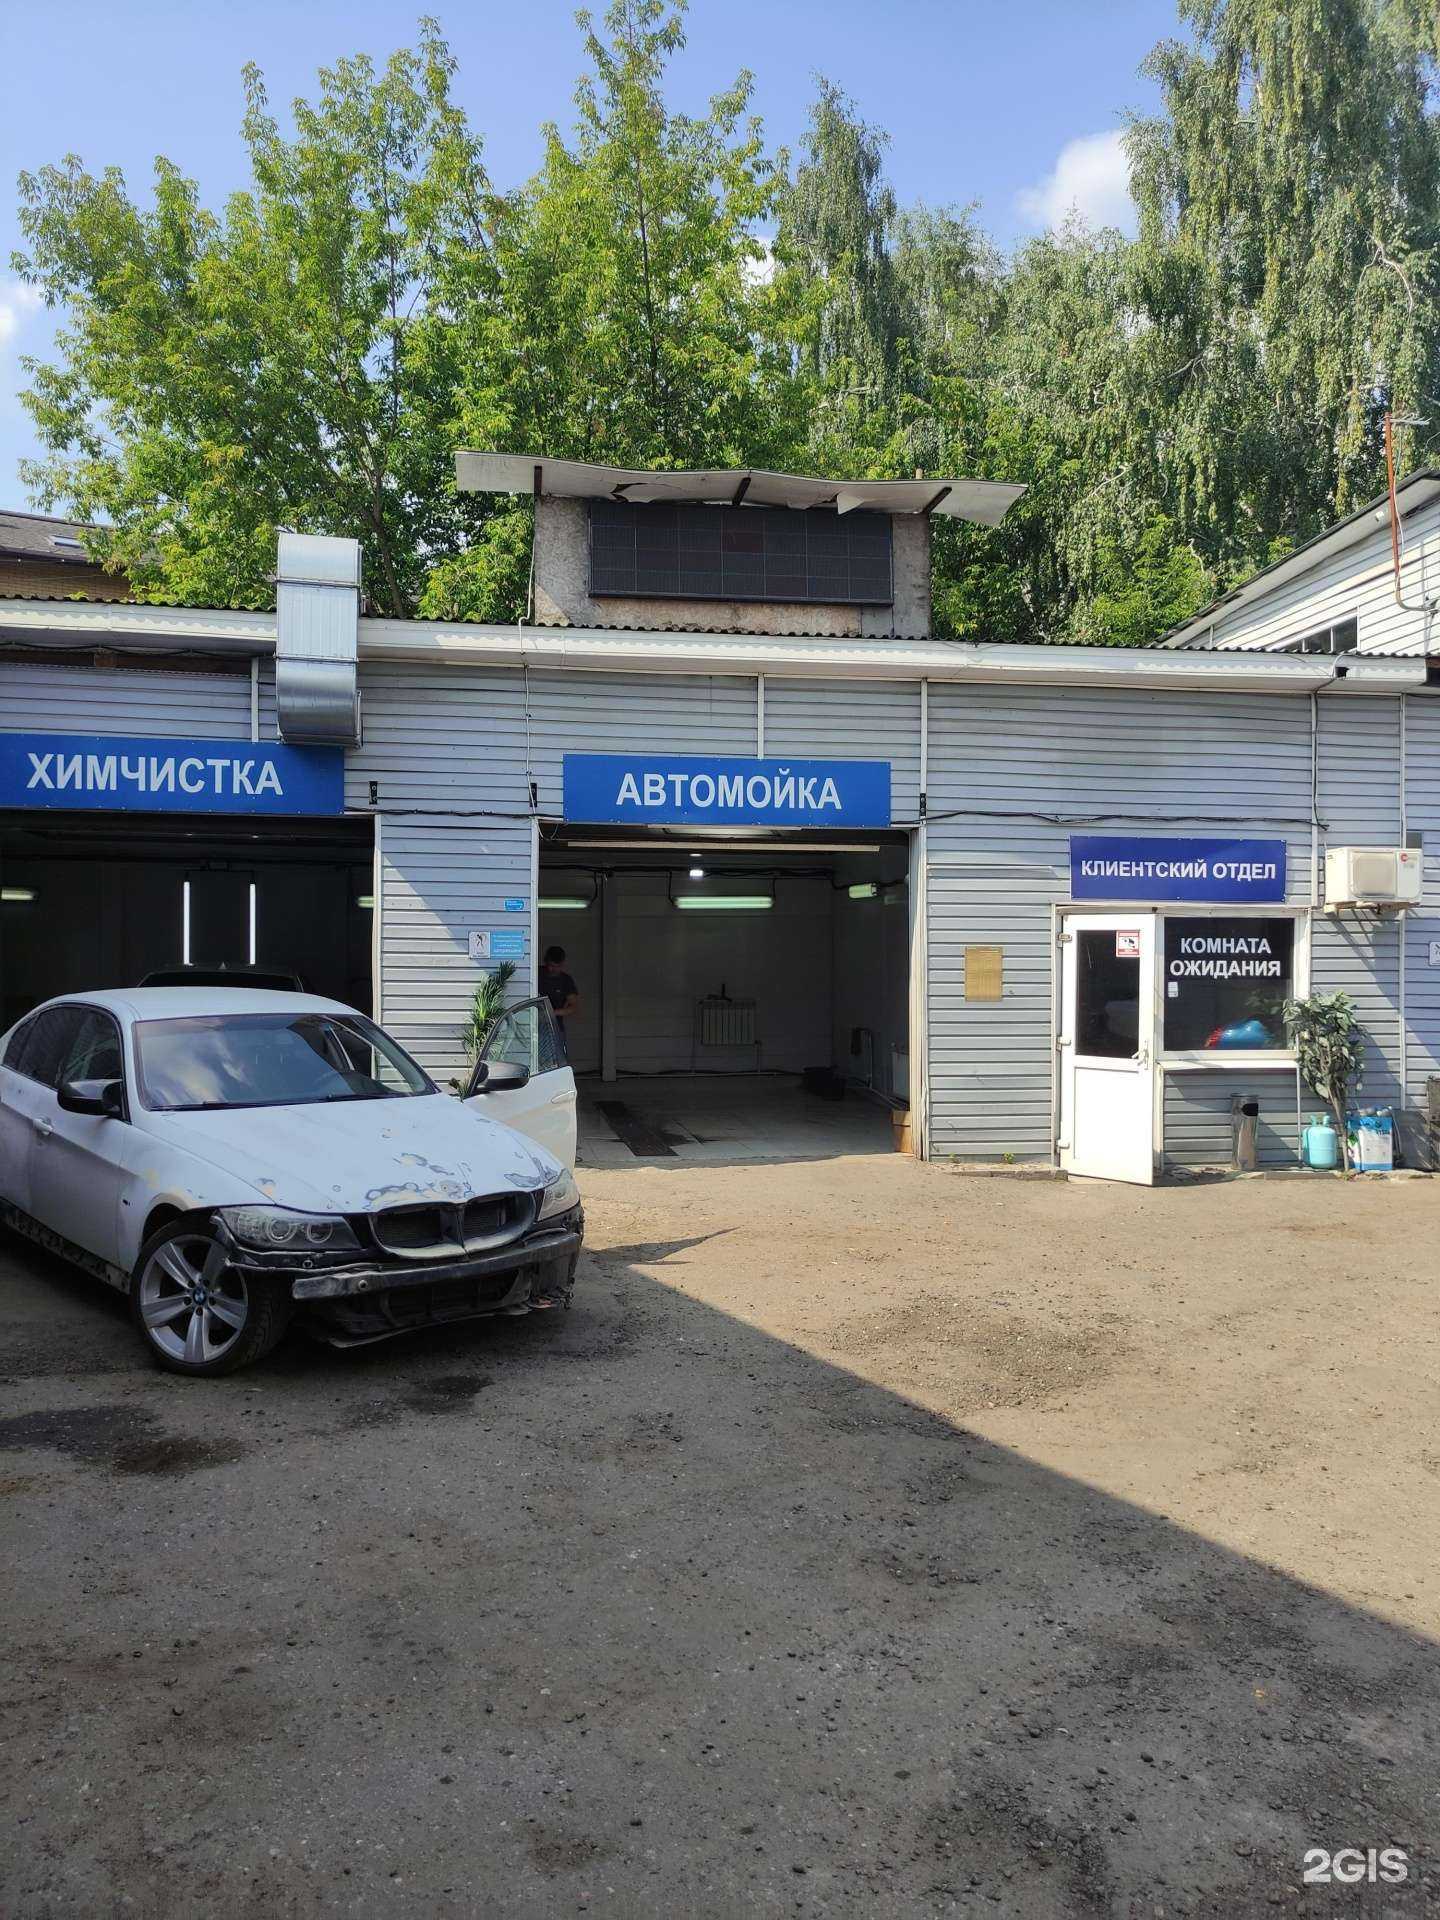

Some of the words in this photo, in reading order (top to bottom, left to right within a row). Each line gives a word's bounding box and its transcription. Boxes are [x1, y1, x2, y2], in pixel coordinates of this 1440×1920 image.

[26, 753, 284, 796] ХИМЧИСТКА
[615, 767, 842, 810] АВТОМОЙКА
[1081, 859, 1207, 878] КЛИЕНТСКИЙ
[1212, 862, 1276, 881] ОТДЕЛ
[1180, 937, 1272, 954] КОМНАТА
[1169, 959, 1281, 979] ОЖИДАНИЯ
